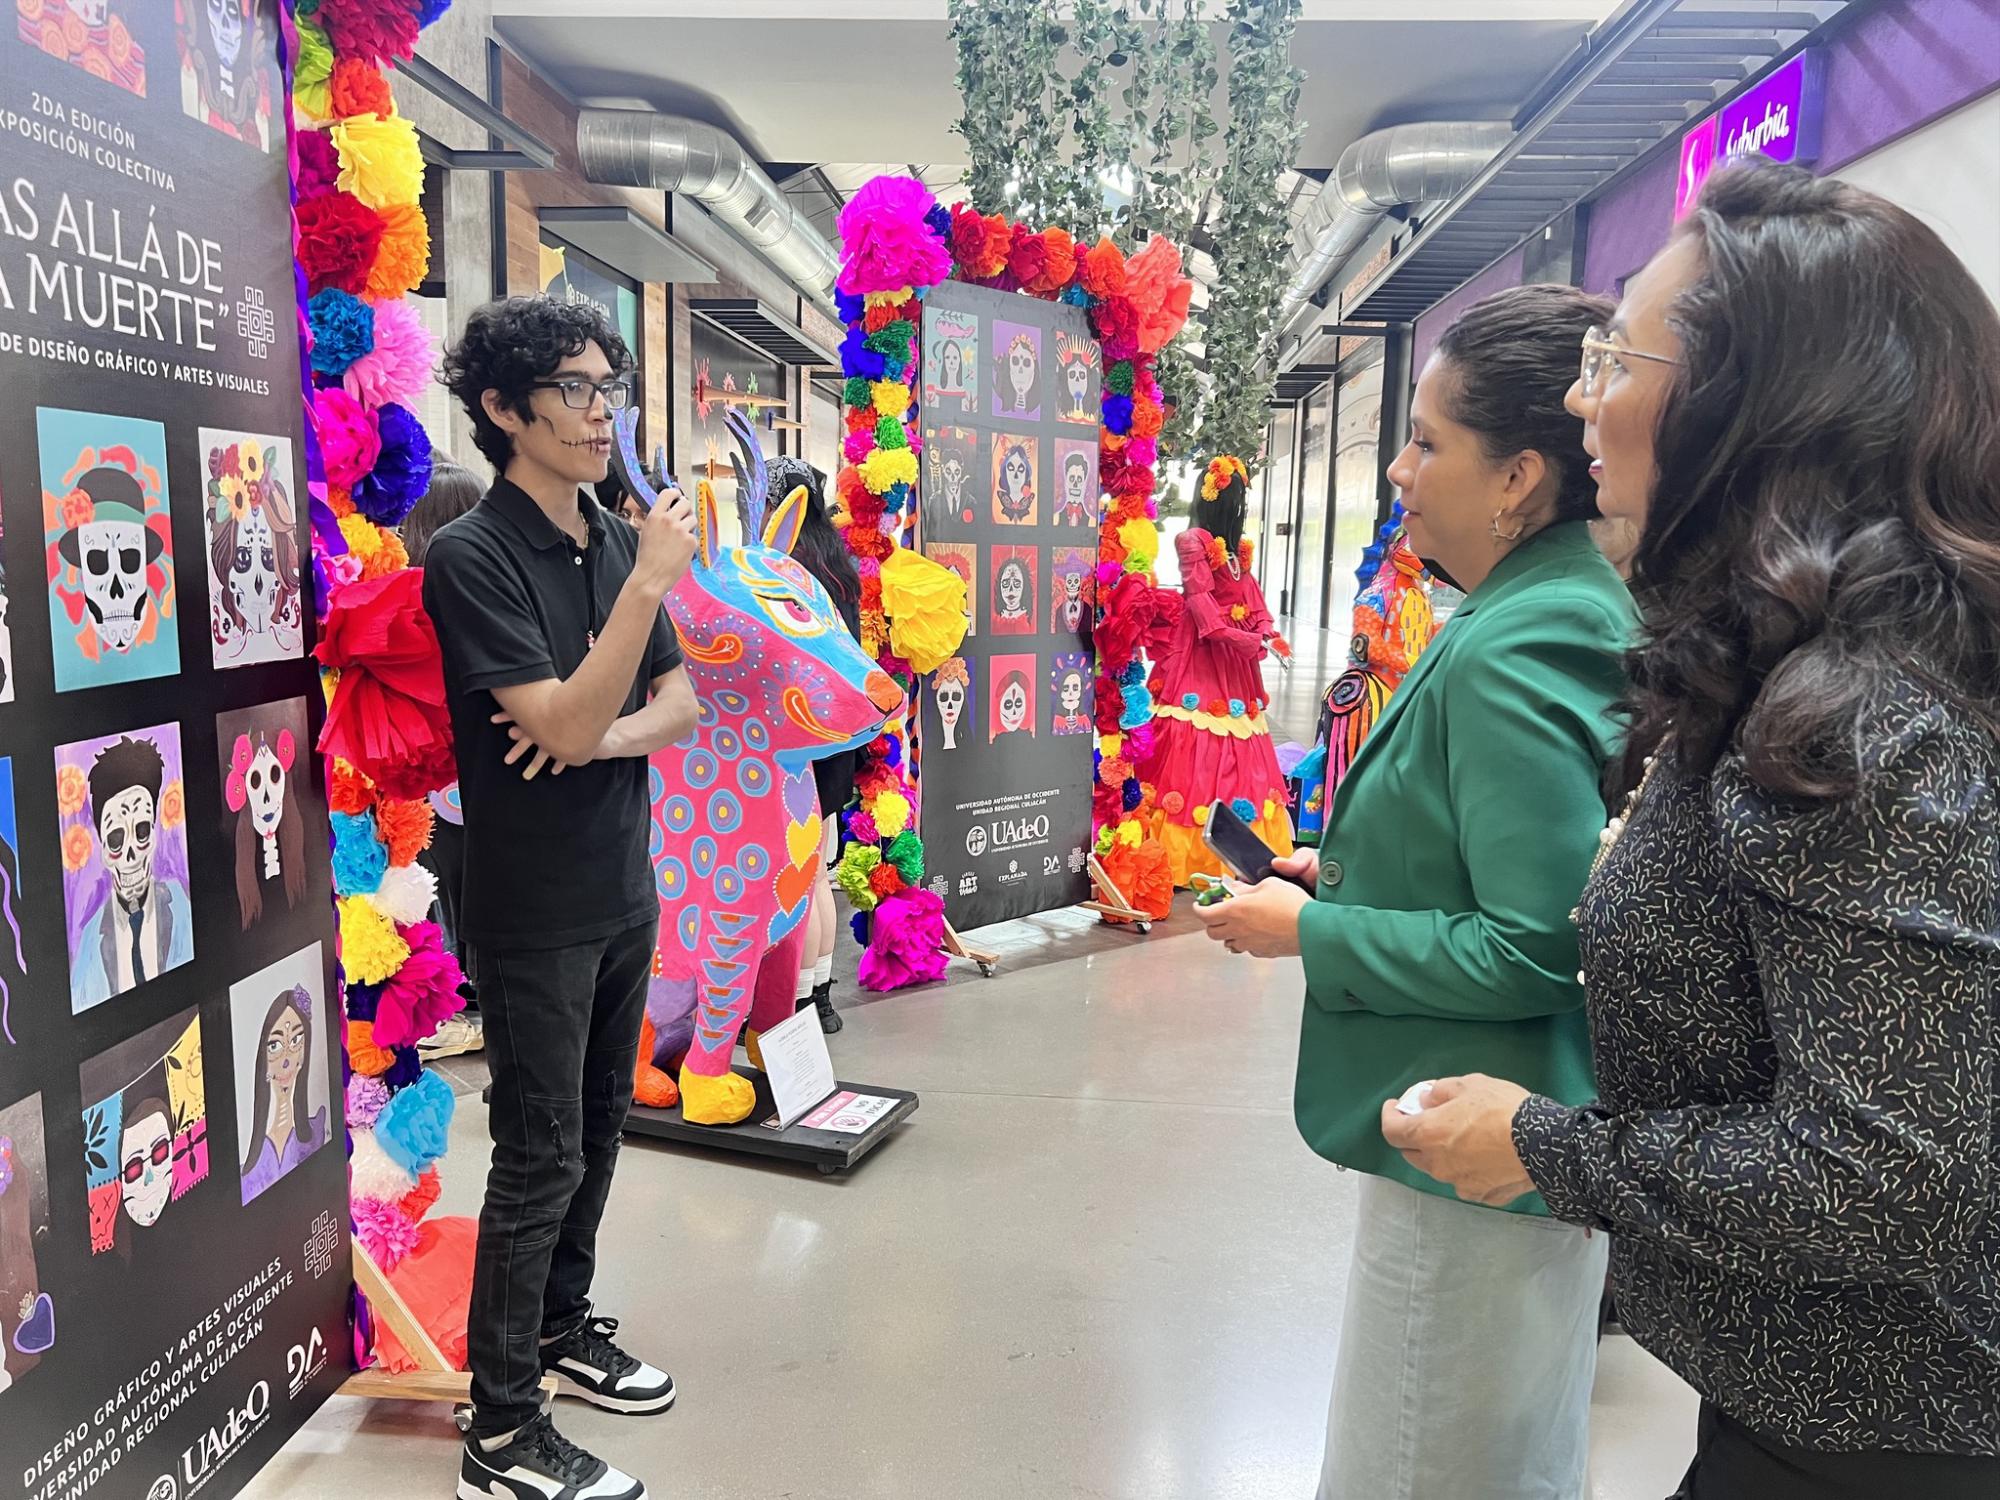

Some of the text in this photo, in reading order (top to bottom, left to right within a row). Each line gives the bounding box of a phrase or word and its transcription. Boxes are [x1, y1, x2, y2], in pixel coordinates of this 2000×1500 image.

[32, 92, 135, 150] 2DA EDICIÓN
[95, 147, 175, 192] COLECTIVA
[50, 192, 170, 279] ALLÁ
[176, 230, 224, 294] DE
[0, 332, 269, 396] DE DISEÑO GRÁFICO Y ARTES VISUALES
[955, 799, 992, 811] UNIVERSIDAD
[1032, 789, 1060, 799] OCCIDENTE
[972, 807, 993, 816] UNIDAD
[994, 802, 1020, 812] REGIONAL
[991, 815, 1050, 845] UAdeO
[24, 1257, 281, 1488] DISEÑO GRÁFICO Y ARTES VISUALES
[121, 1353, 202, 1433] AUTÓNOMA
[206, 1332, 224, 1357] DE
[227, 1270, 294, 1337] OCCIDENTE
[127, 1380, 197, 1452] REGIONAL
[201, 1319, 263, 1383] CULIACÁN
[182, 1380, 270, 1485] UAdeO
